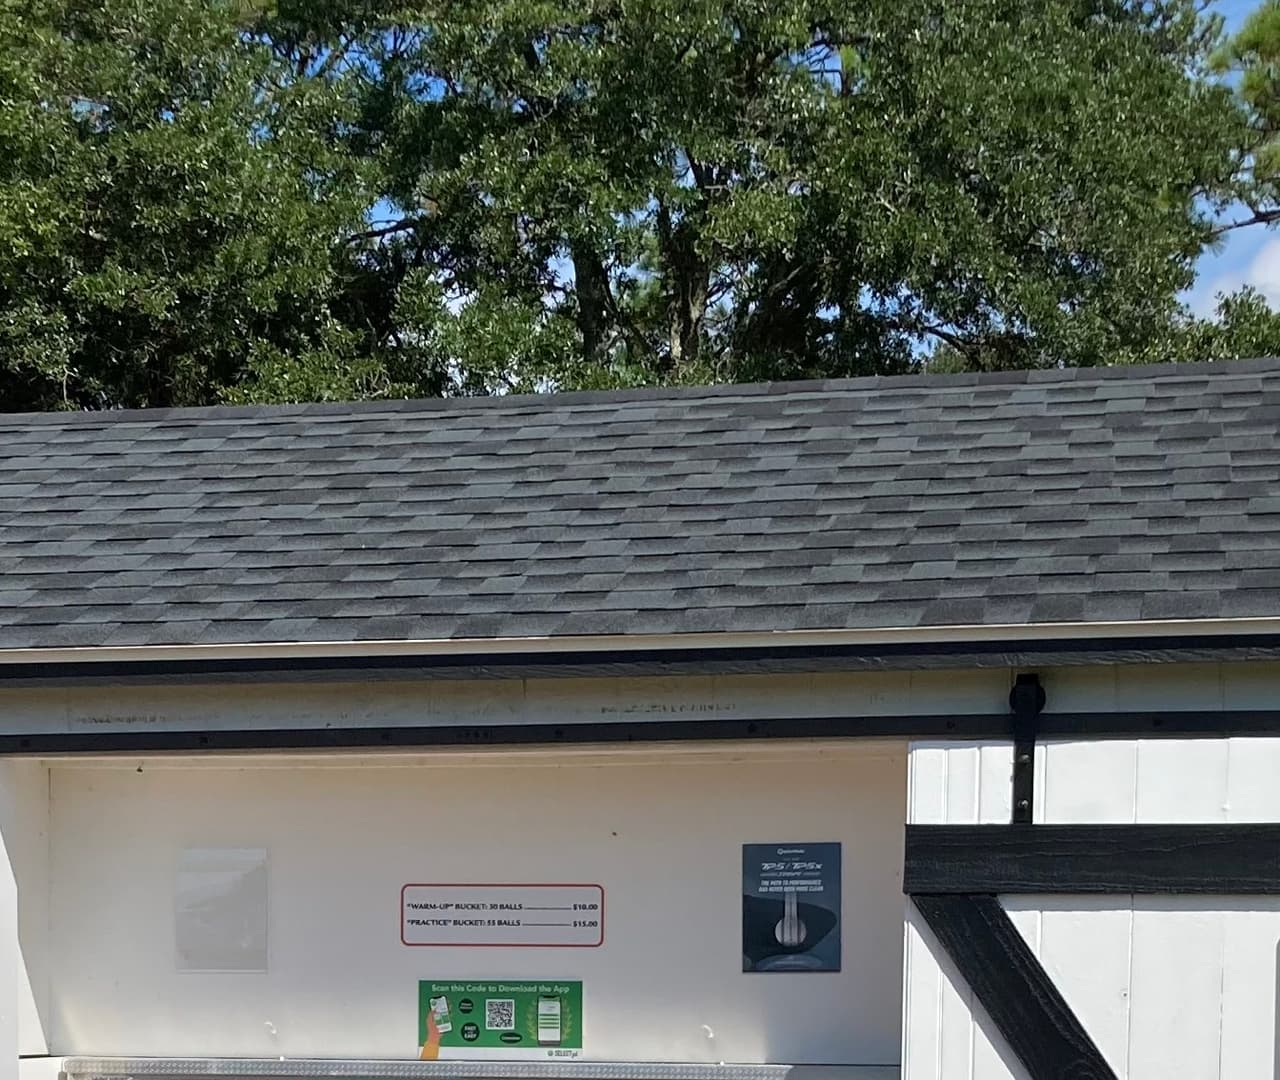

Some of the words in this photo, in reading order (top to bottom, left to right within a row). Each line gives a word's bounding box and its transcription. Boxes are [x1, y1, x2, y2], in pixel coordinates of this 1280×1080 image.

[573, 920, 598, 928] $15.00
[431, 984, 449, 992] Scan
[451, 984, 465, 992] this
[466, 984, 486, 992] Code
[498, 985, 537, 993] Download
[539, 985, 552, 993] the
[553, 985, 570, 994] App
